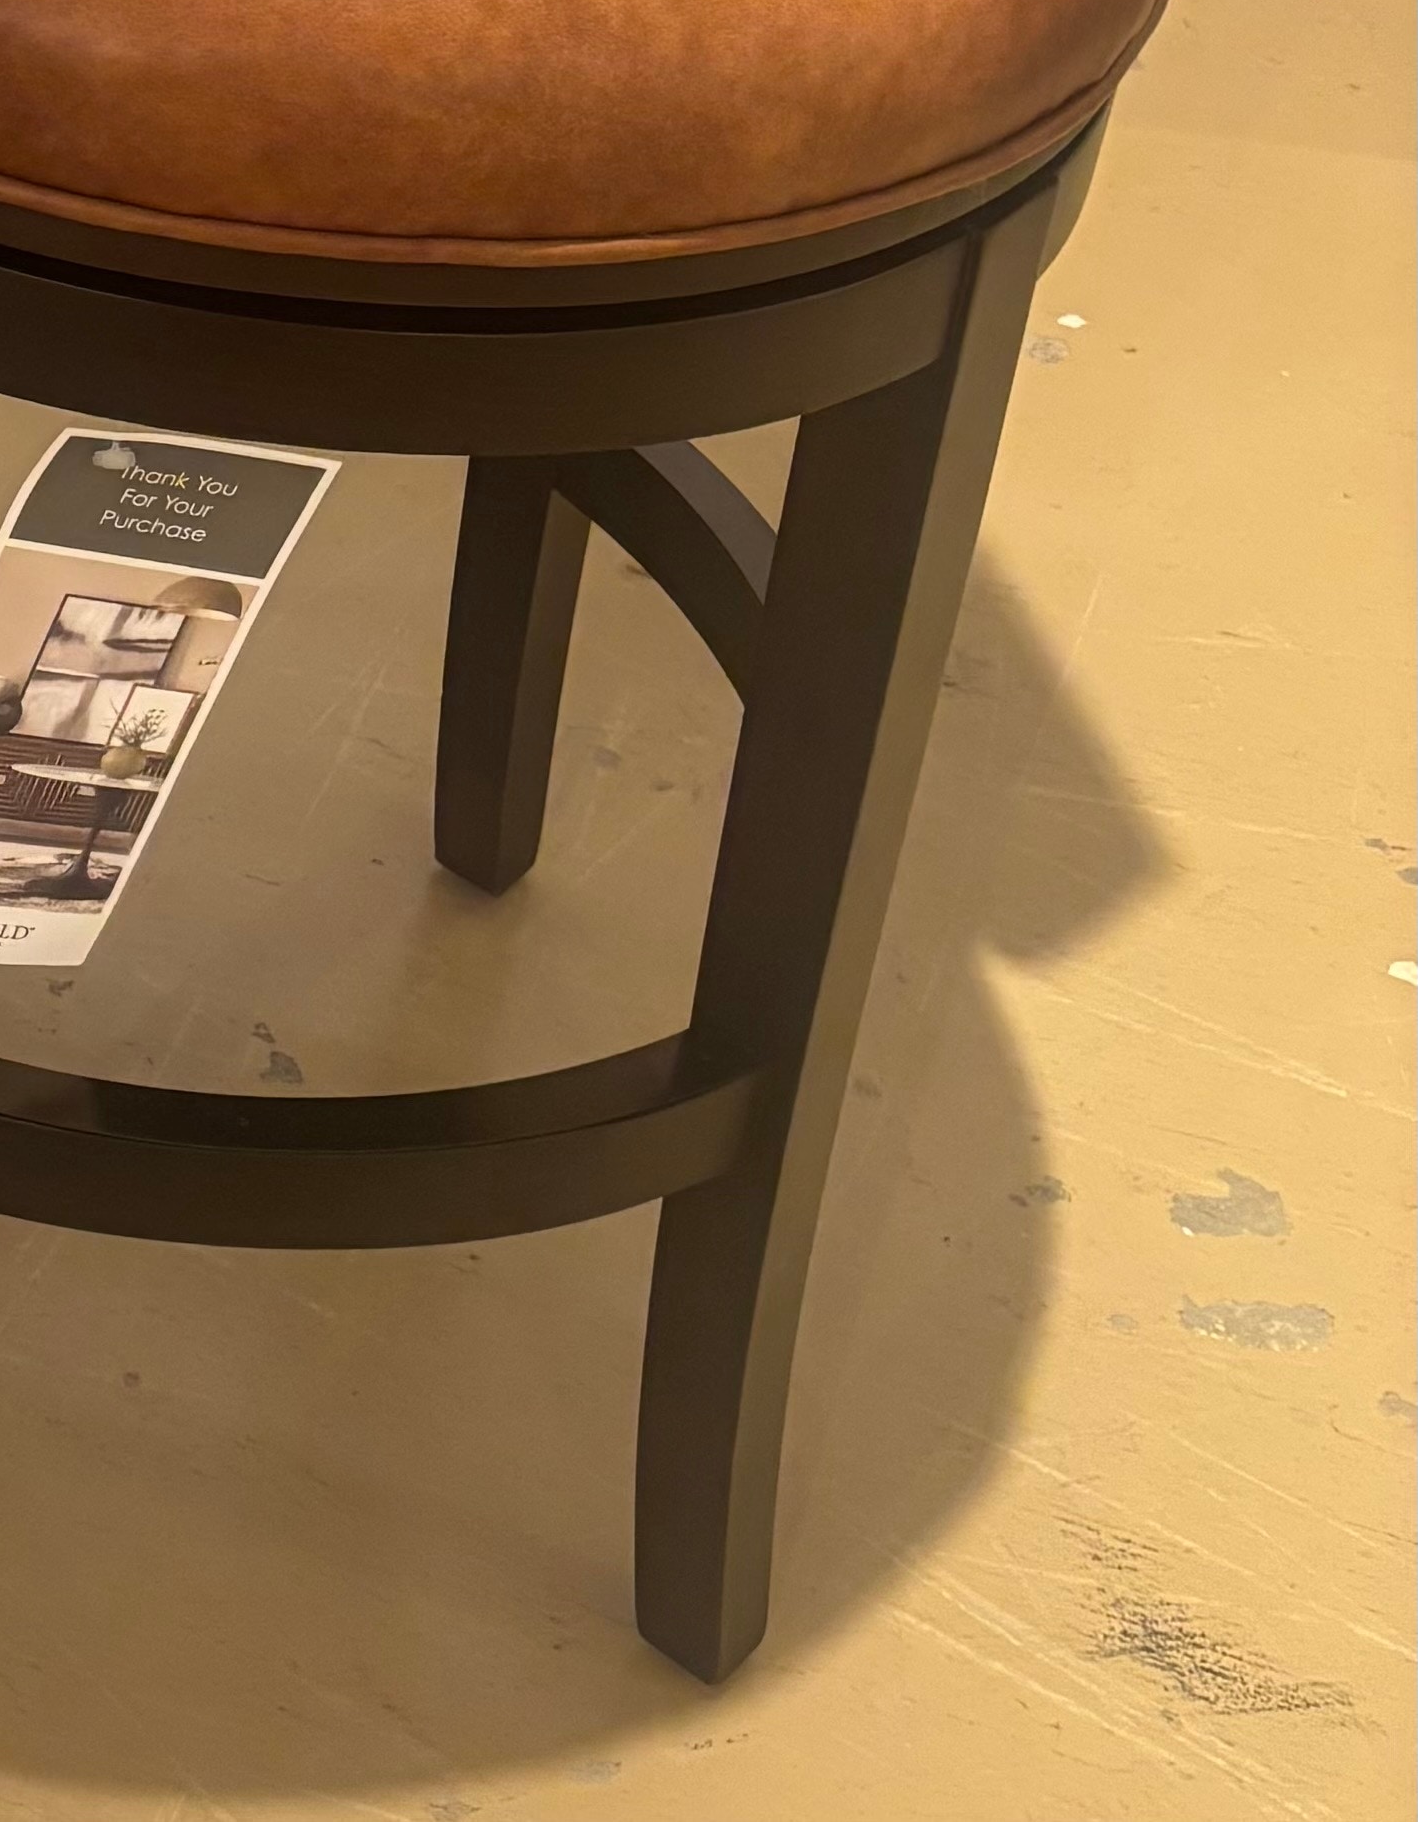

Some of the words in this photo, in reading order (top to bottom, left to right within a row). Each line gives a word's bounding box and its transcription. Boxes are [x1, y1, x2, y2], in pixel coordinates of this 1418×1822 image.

[197, 475, 238, 496] You
[120, 488, 157, 508] For
[165, 494, 214, 518] Your
[99, 509, 207, 542] Purchase
